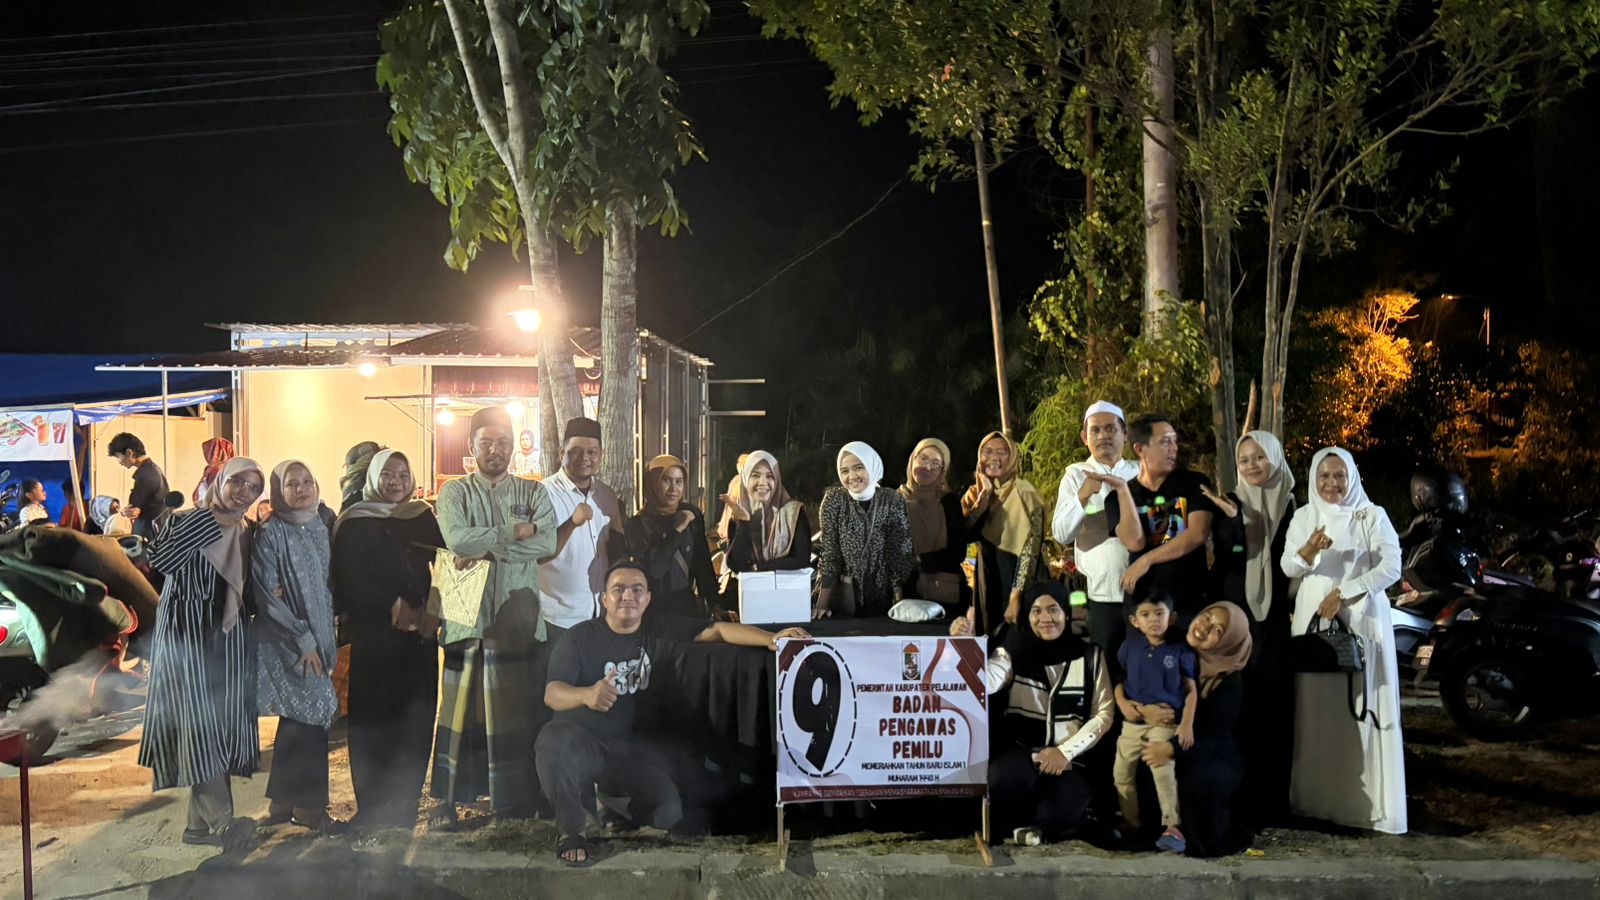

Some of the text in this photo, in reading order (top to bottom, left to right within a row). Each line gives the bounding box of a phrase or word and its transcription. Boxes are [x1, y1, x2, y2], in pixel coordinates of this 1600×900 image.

[857, 683, 967, 692] PEMERINTAH KABUPATEN PELALAWAN
[793, 651, 841, 772] 9
[892, 695, 941, 713] BADAN
[879, 718, 956, 736] PENGAWAS
[893, 741, 943, 759] PEMILU
[861, 762, 905, 770] MEMERIAHKAN
[906, 762, 925, 770] TAHUN
[926, 762, 943, 770] BARU
[944, 761, 962, 769] ISLAM
[888, 774, 918, 782] MUHARAM
